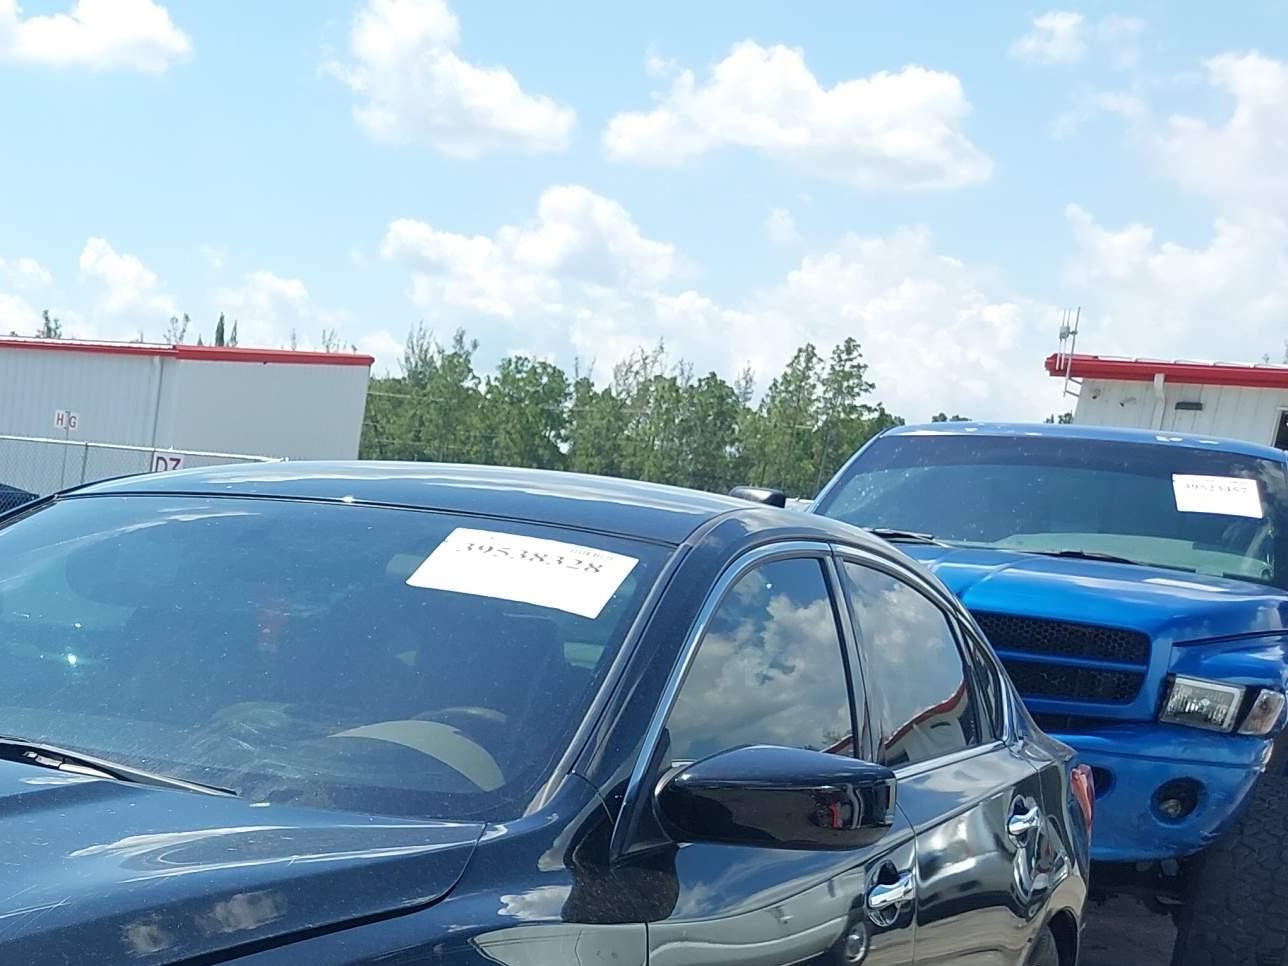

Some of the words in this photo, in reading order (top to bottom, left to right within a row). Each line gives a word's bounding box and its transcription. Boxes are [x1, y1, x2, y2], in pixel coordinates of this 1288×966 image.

[55, 412, 64, 427] H
[68, 415, 78, 429] G
[456, 542, 604, 574] 39538328
